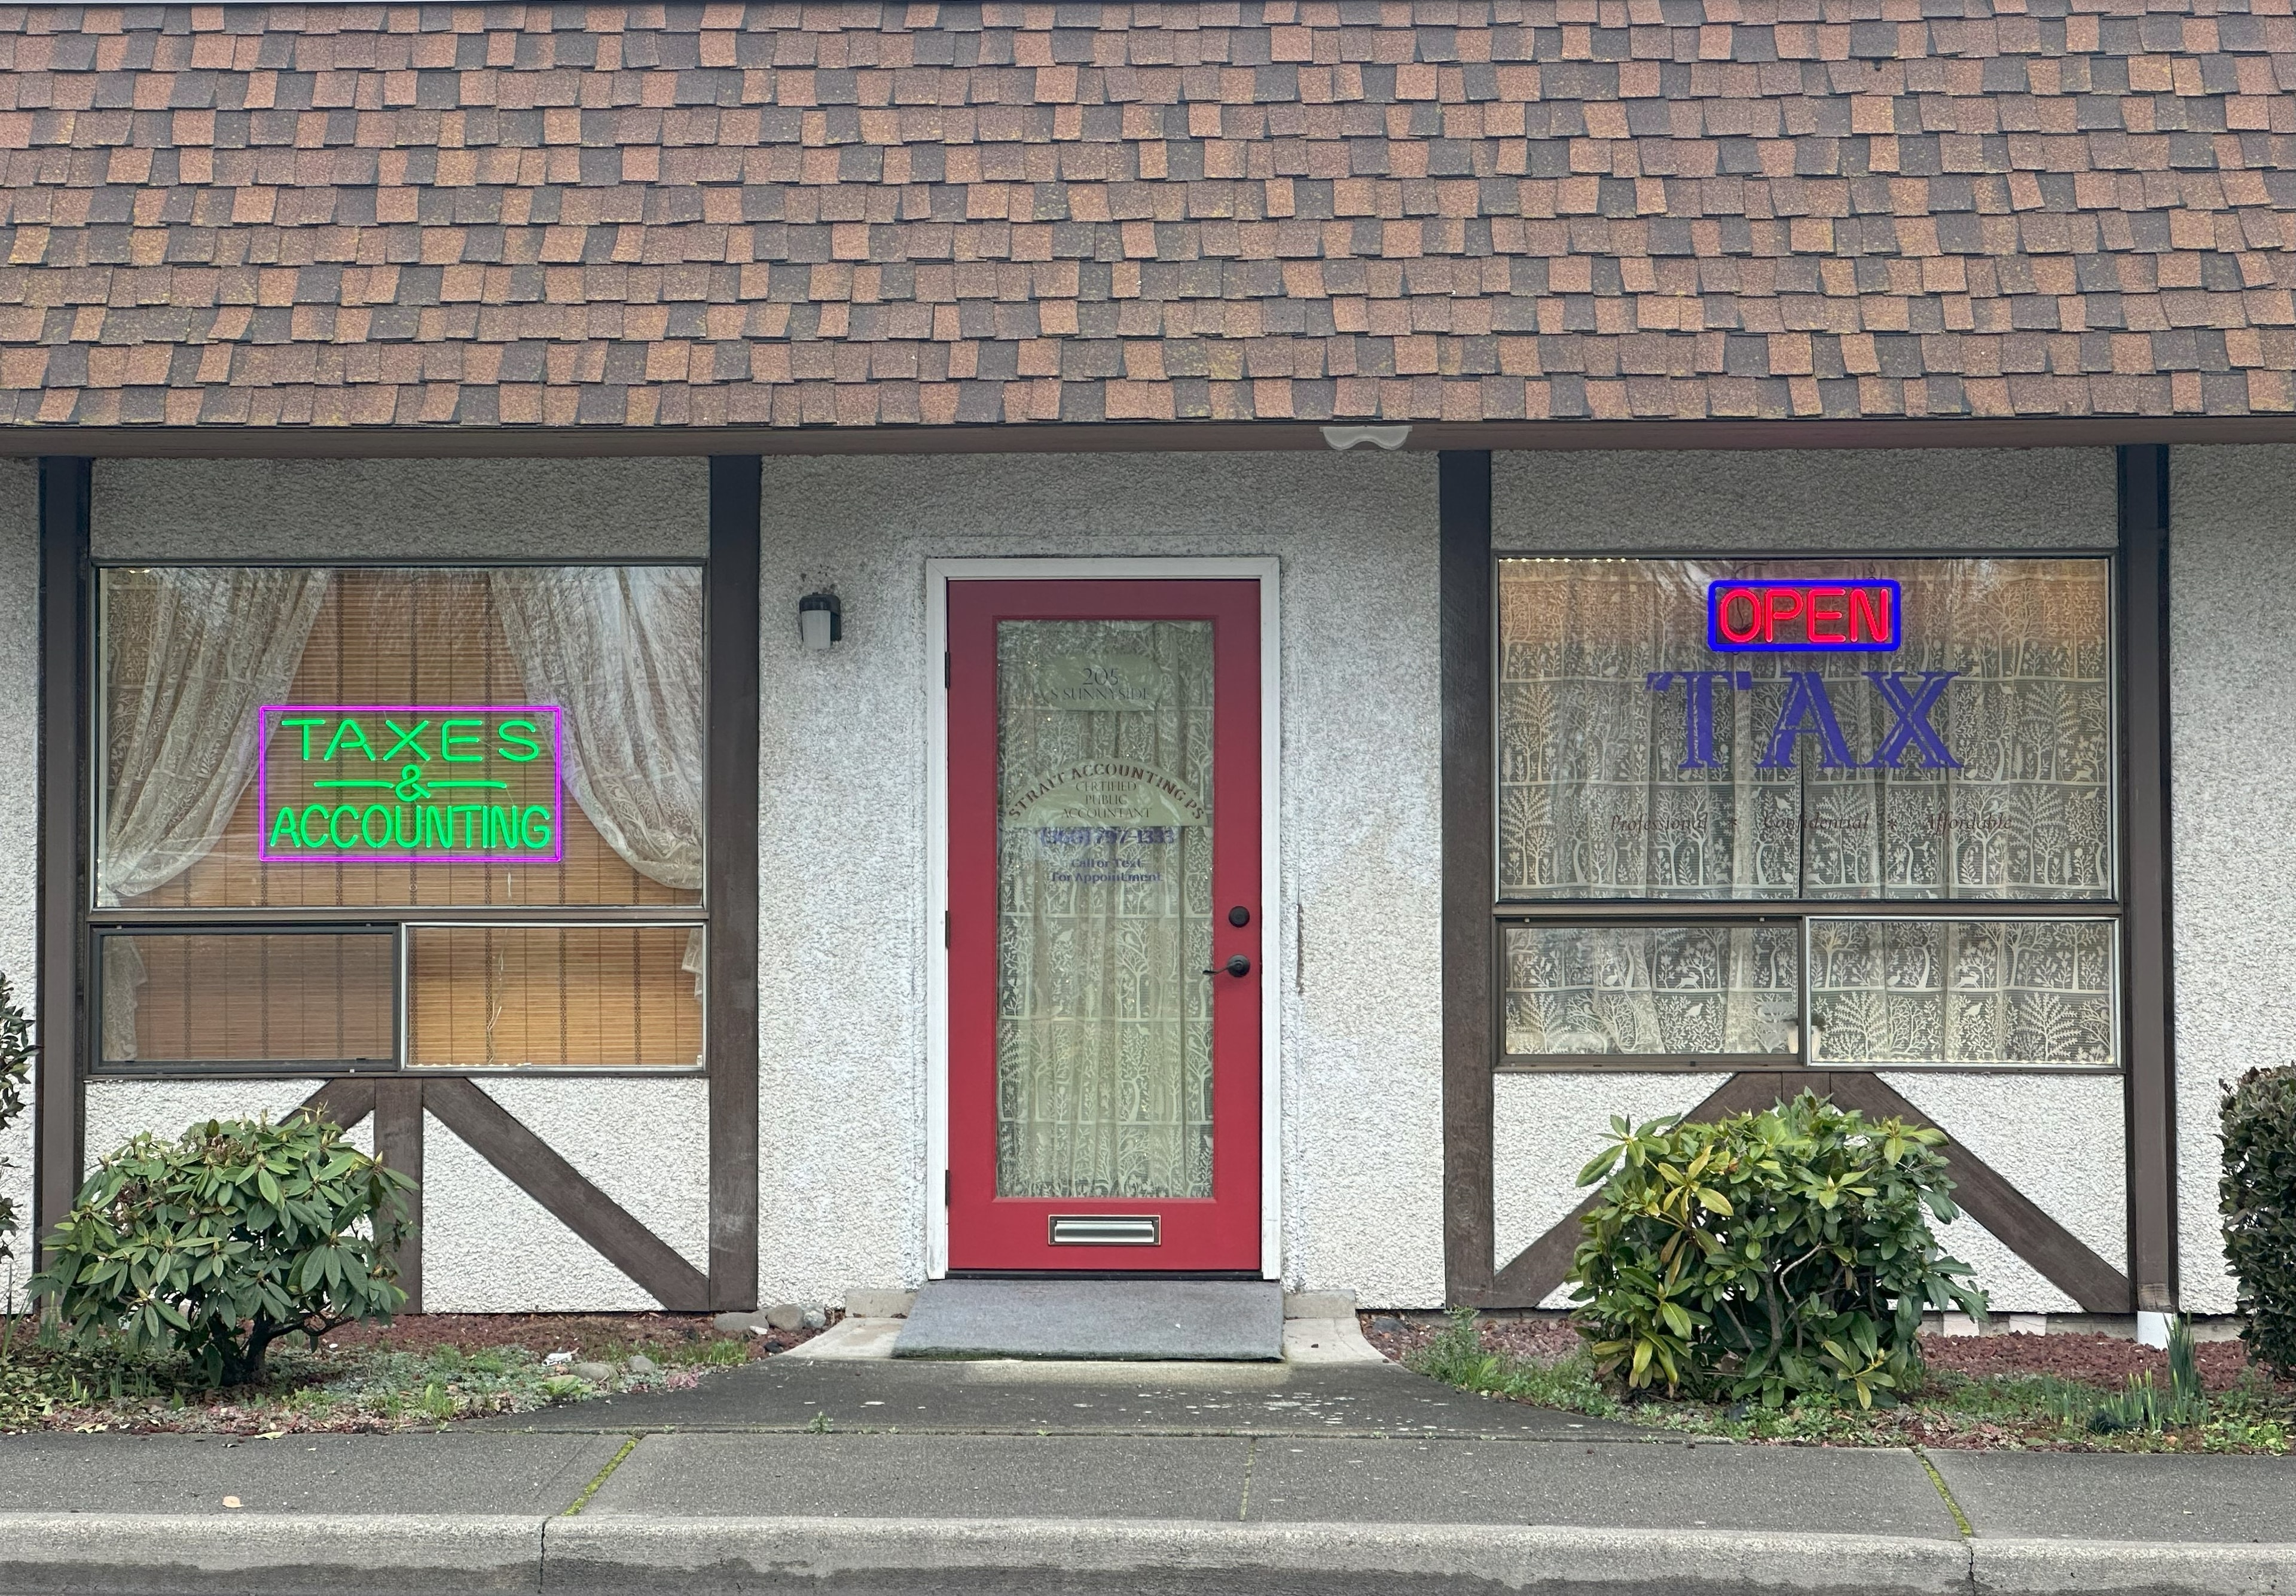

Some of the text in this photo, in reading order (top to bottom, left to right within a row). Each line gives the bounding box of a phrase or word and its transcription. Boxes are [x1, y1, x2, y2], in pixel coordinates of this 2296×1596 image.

[1718, 587, 1890, 643] OPEN
[1083, 667, 1119, 686] 205
[1051, 688, 1149, 700] S SUNNYSIDE
[1645, 670, 1965, 770] TAX
[280, 718, 540, 762] TAXES
[395, 764, 432, 802] &
[1008, 762, 1204, 822] STRAIT ACCOUNTING PS
[1075, 780, 1137, 792] CERTIFIED
[1085, 794, 1128, 805] PUBLIC
[1061, 807, 1153, 819] ACCOUNTANT
[1610, 811, 2013, 837] Professional Confidential Affordable
[270, 804, 551, 849] ACCOUNTING
[1071, 859, 1094, 868] Call
[1113, 859, 1141, 868] Text
